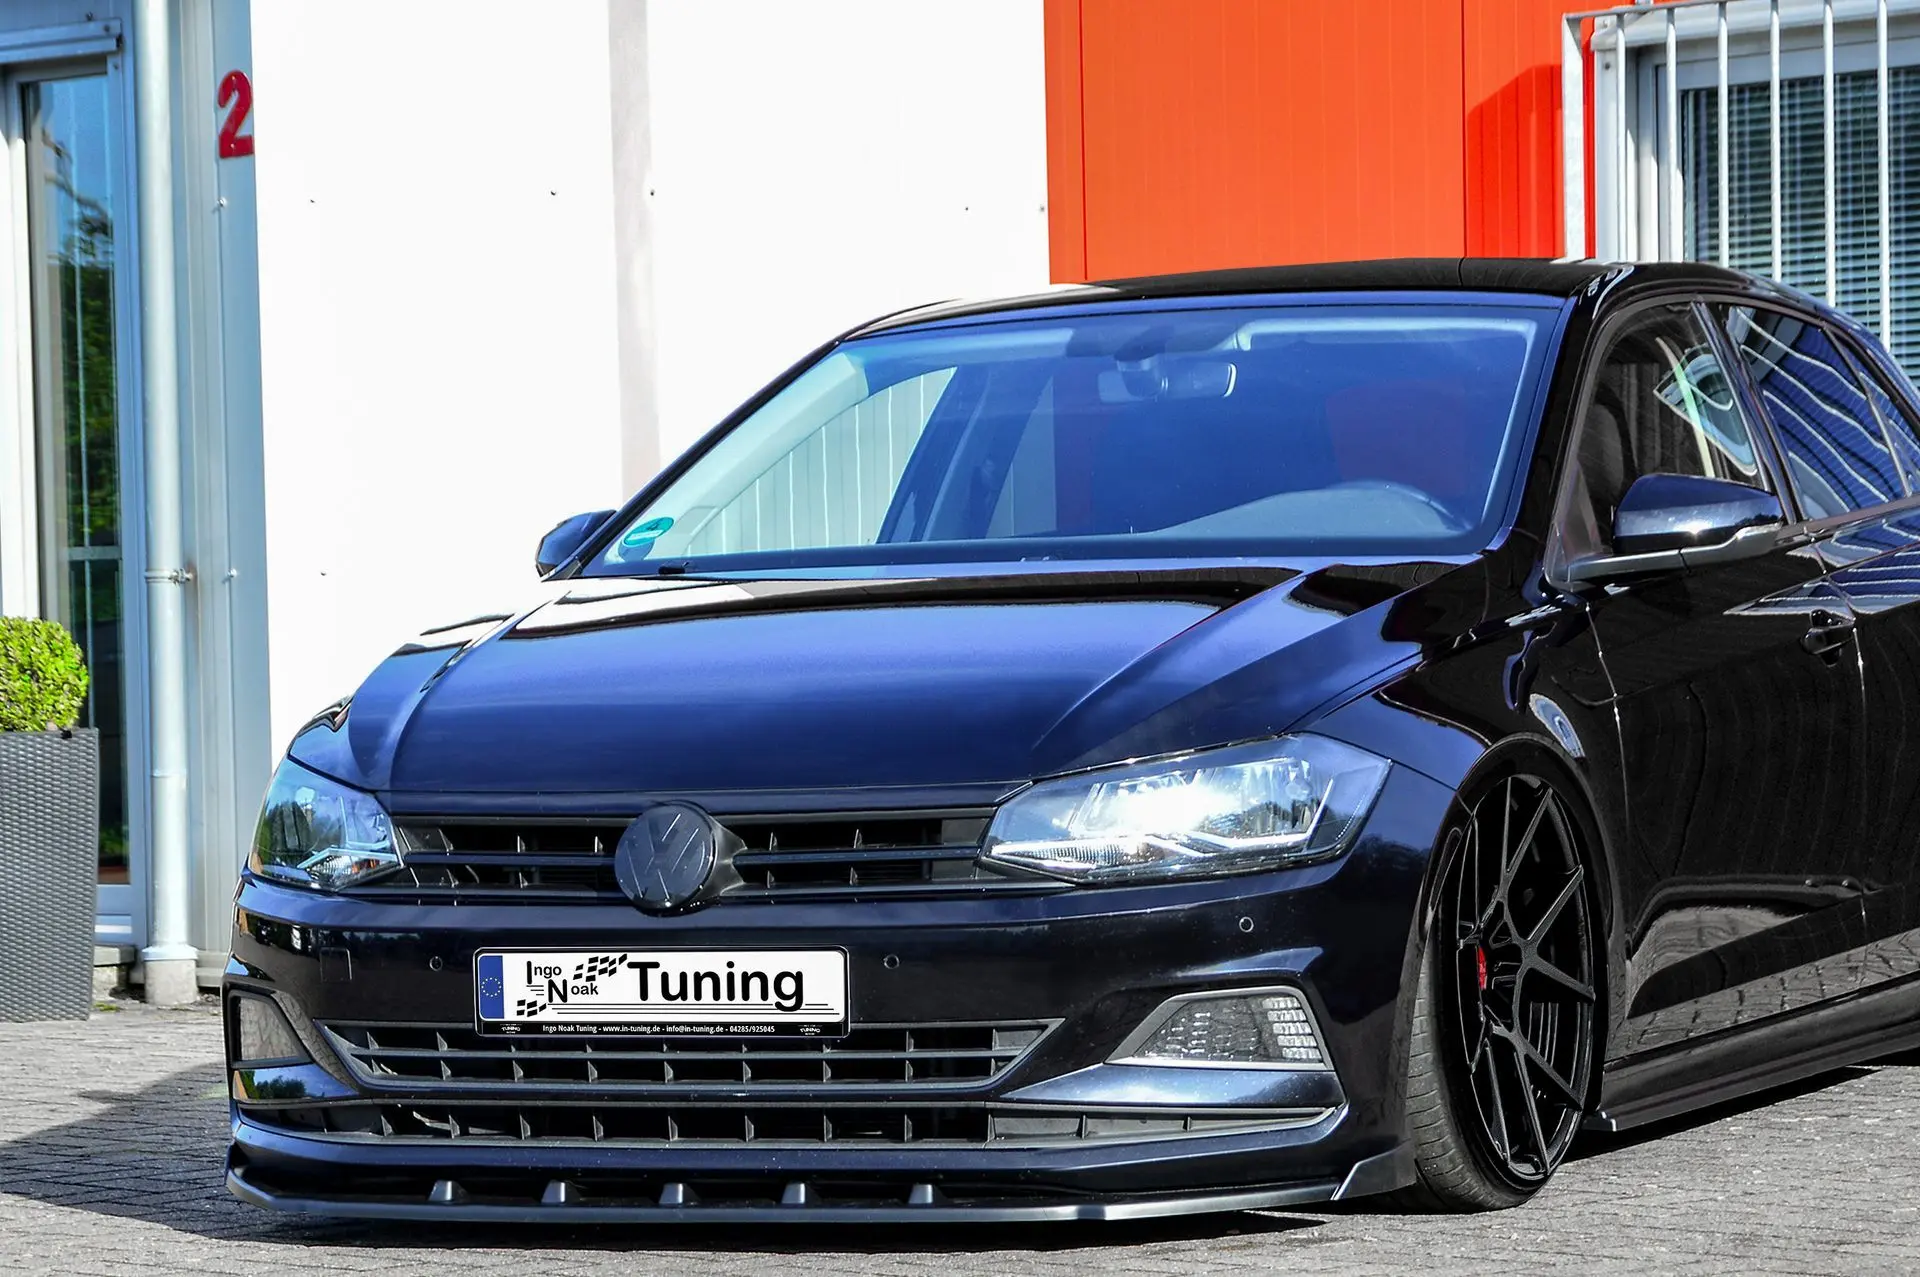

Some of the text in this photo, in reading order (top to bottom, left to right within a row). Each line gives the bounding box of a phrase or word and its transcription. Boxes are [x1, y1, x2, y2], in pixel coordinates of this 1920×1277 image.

[218, 70, 254, 158] 2
[526, 960, 562, 985] Ingo
[547, 979, 599, 1003] Noak
[626, 961, 803, 1012] Tuning
[542, 1024, 557, 1034] Ingo
[558, 1024, 575, 1032] Noak
[575, 1024, 597, 1034] Tuning
[602, 1024, 661, 1034] www.in-tuning.de
[666, 1024, 724, 1035] info@in-tuning.de
[729, 1025, 776, 1033] 04285/925045
